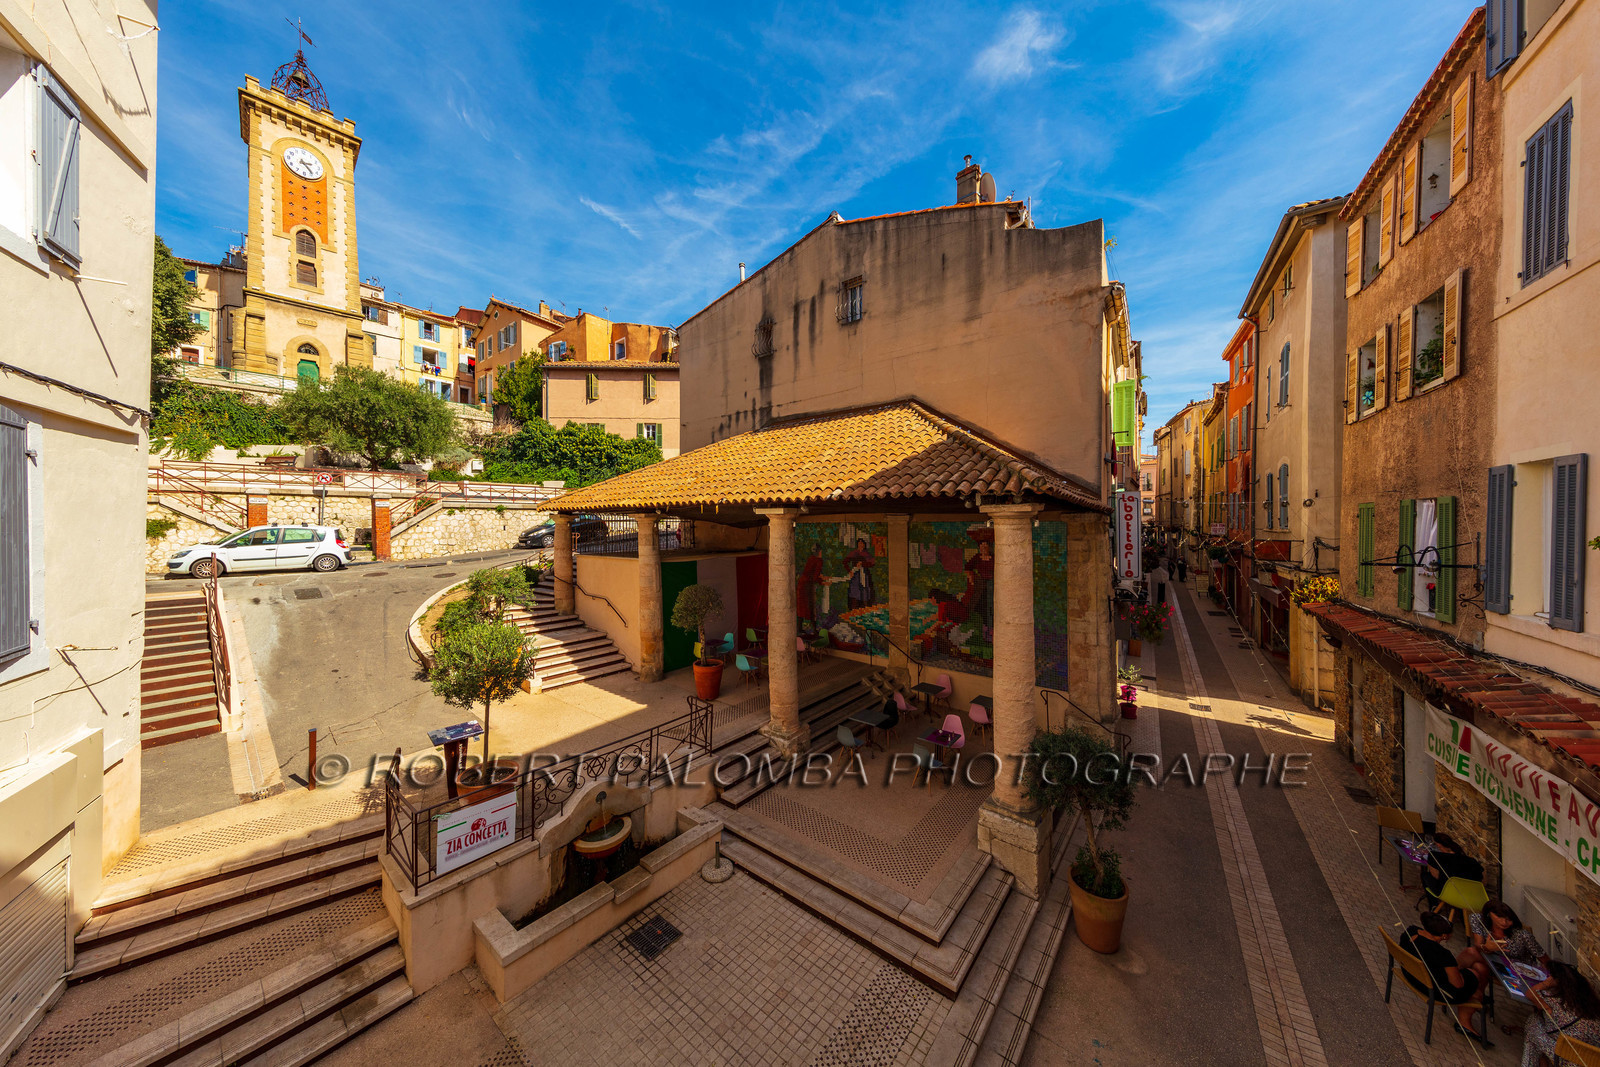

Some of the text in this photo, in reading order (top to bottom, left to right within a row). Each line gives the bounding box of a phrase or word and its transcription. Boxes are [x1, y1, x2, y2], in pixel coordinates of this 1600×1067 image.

[1122, 494, 1135, 502] la
[1474, 763, 1558, 845] SICILIENNE
[447, 838, 462, 855] ZIA
[464, 820, 507, 847] CONCETTA
